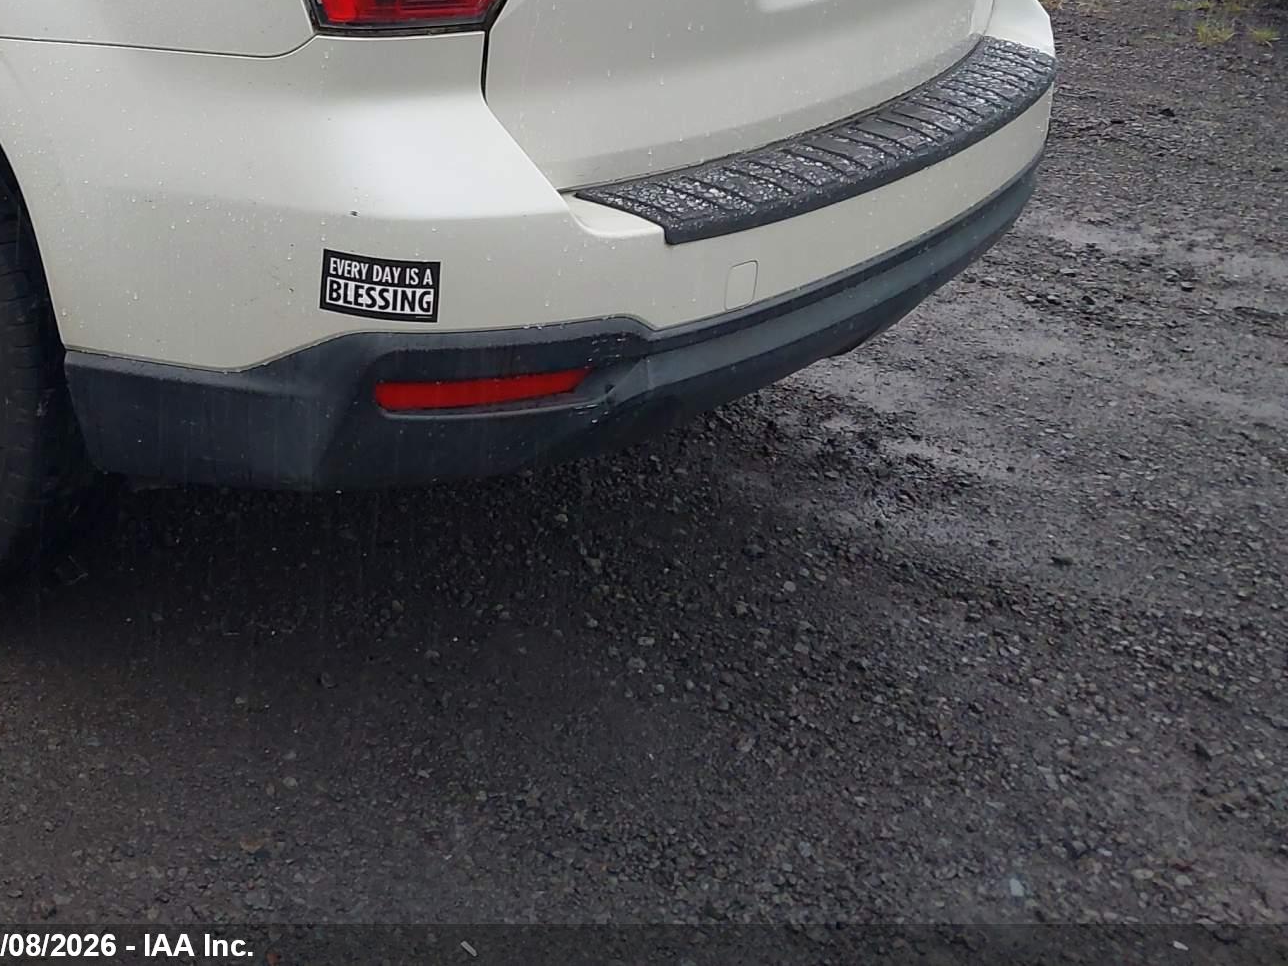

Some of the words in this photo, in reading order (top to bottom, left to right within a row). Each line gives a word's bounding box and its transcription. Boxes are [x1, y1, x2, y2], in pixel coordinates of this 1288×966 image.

[329, 257, 369, 280] EVERY
[372, 264, 401, 284] DAY
[405, 268, 419, 286] IS
[422, 268, 433, 286] A
[328, 279, 432, 313] BLESSING
